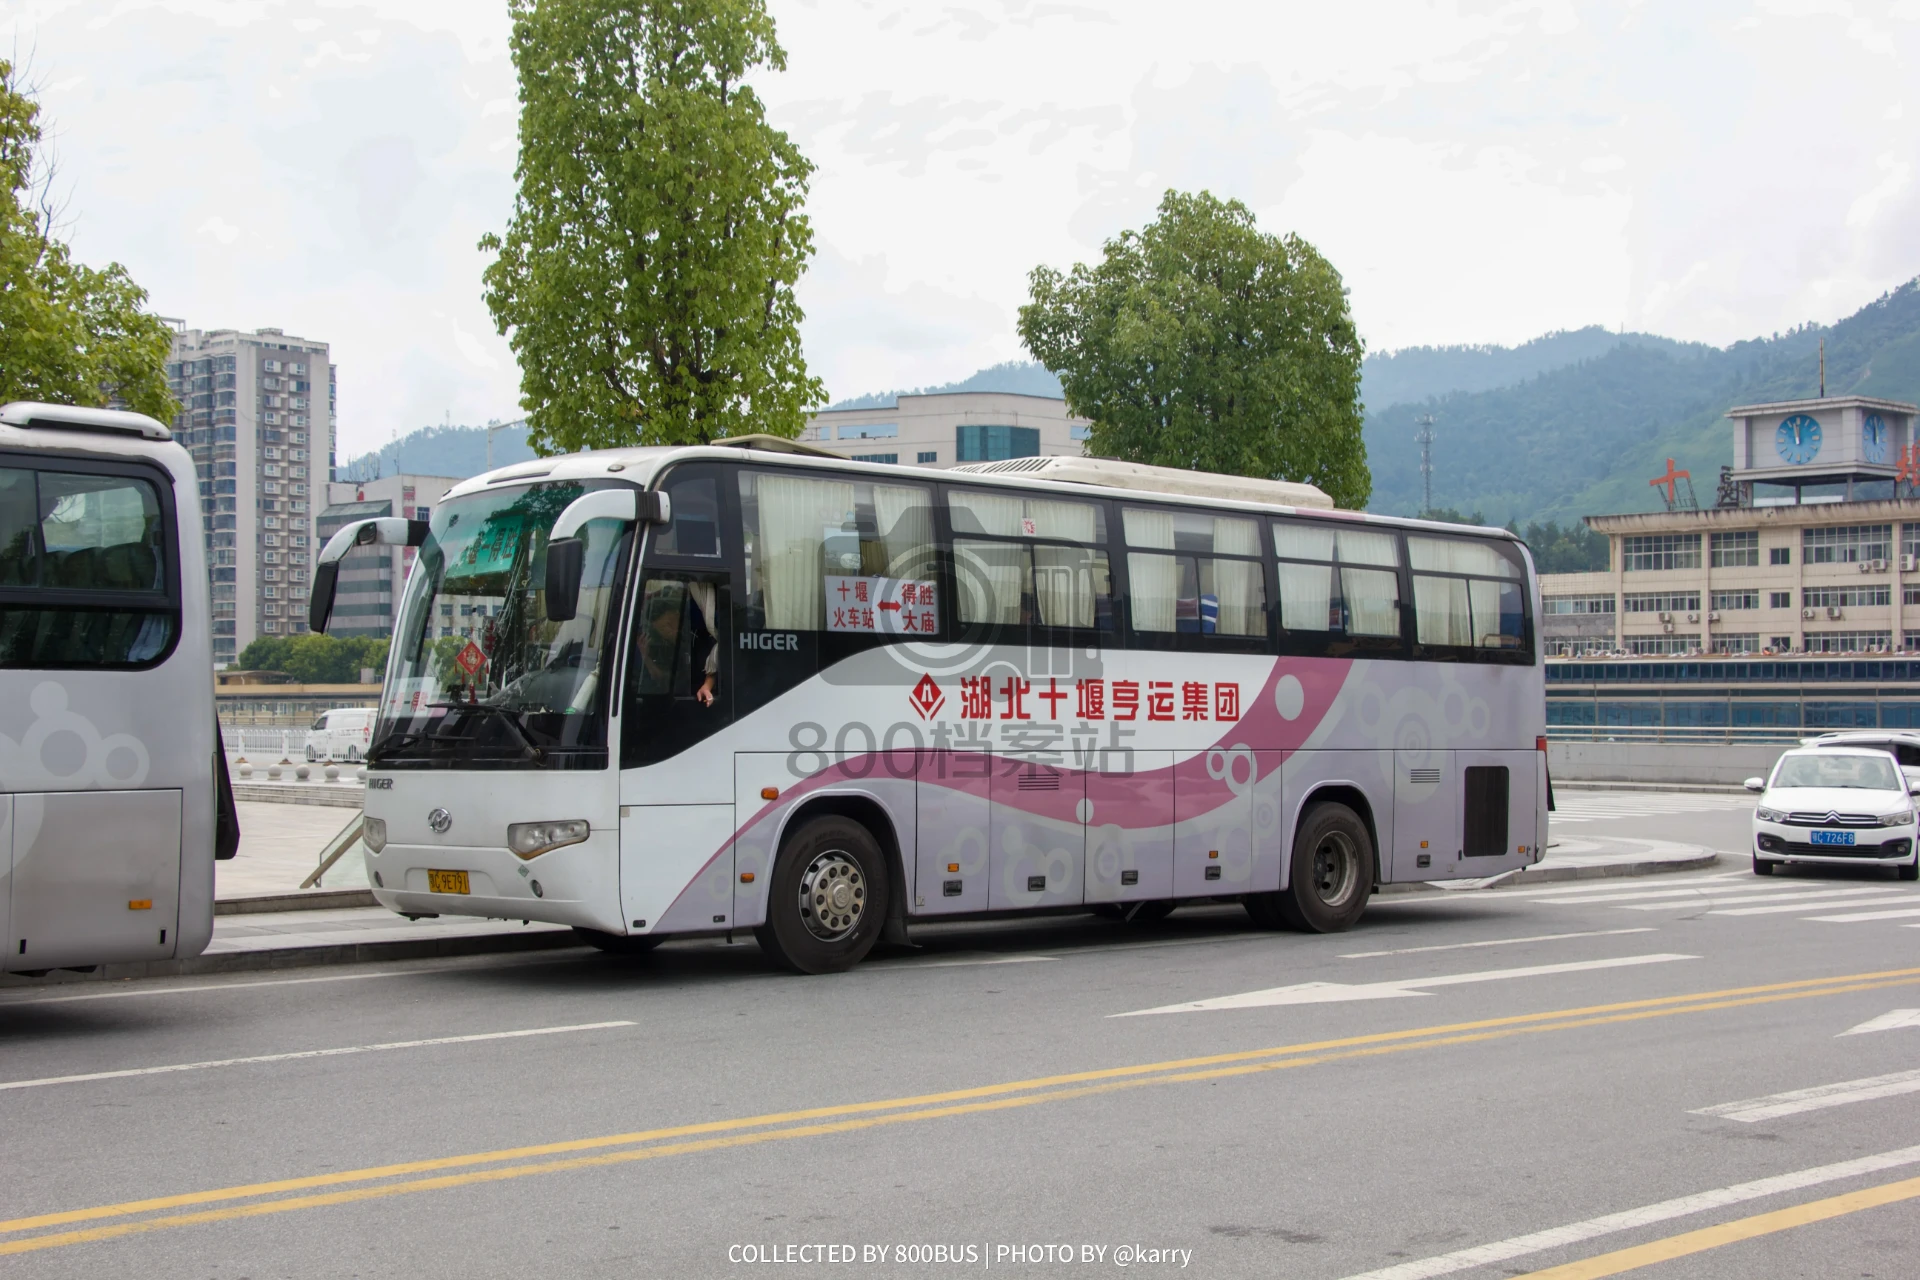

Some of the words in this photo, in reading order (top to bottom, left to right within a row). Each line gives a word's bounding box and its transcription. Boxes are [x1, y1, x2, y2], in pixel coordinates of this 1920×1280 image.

[837, 580, 868, 602] 十堰
[901, 583, 935, 606] 得胜
[833, 607, 875, 630] 火车站
[902, 610, 935, 633] 大庙
[739, 632, 799, 651] HIGER
[960, 675, 1240, 722] 湖北十堰亨运集团
[368, 778, 394, 791] HIGER
